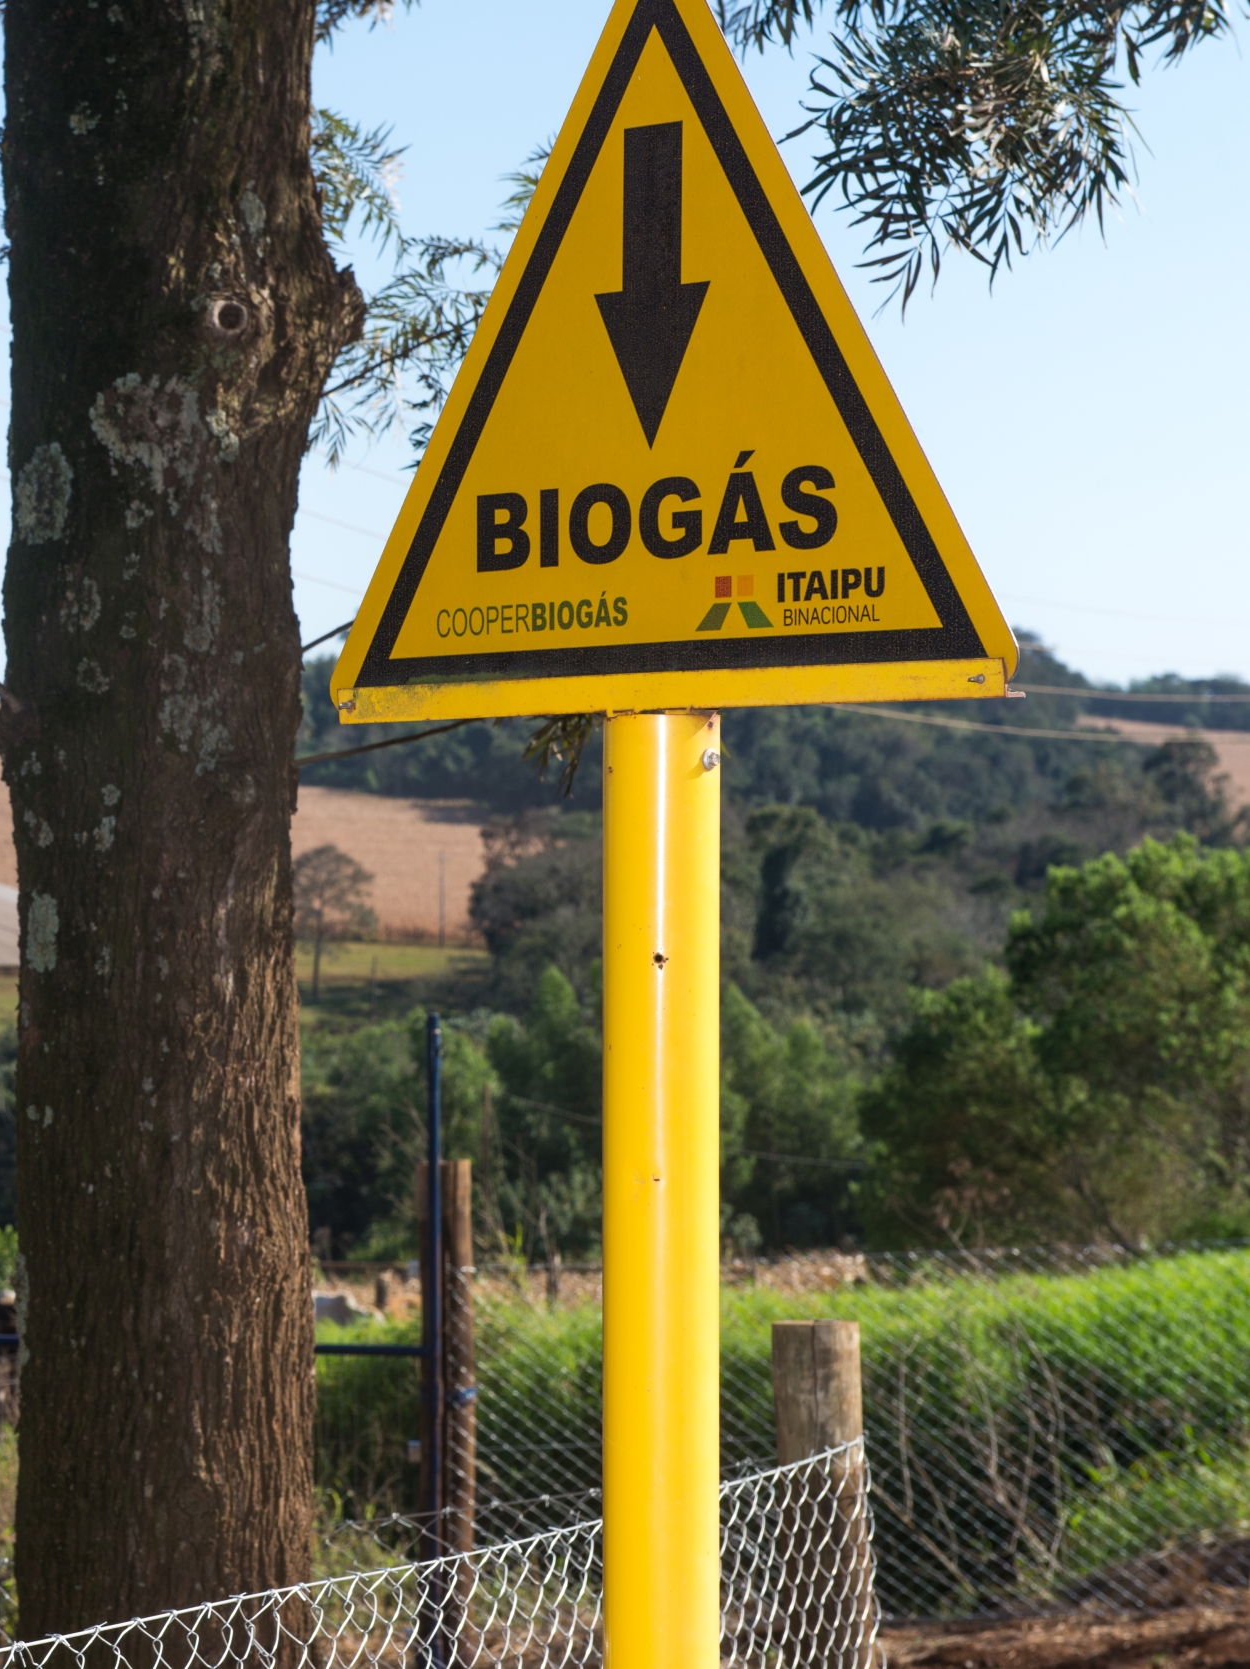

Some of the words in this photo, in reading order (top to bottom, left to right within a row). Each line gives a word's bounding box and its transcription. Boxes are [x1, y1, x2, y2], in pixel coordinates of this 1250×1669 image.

[477, 450, 838, 572] BIOGÁS
[777, 566, 886, 603] ITAIPU
[436, 591, 629, 638] COOPERBIOGÁS
[782, 604, 880, 627] BINACIONAL
